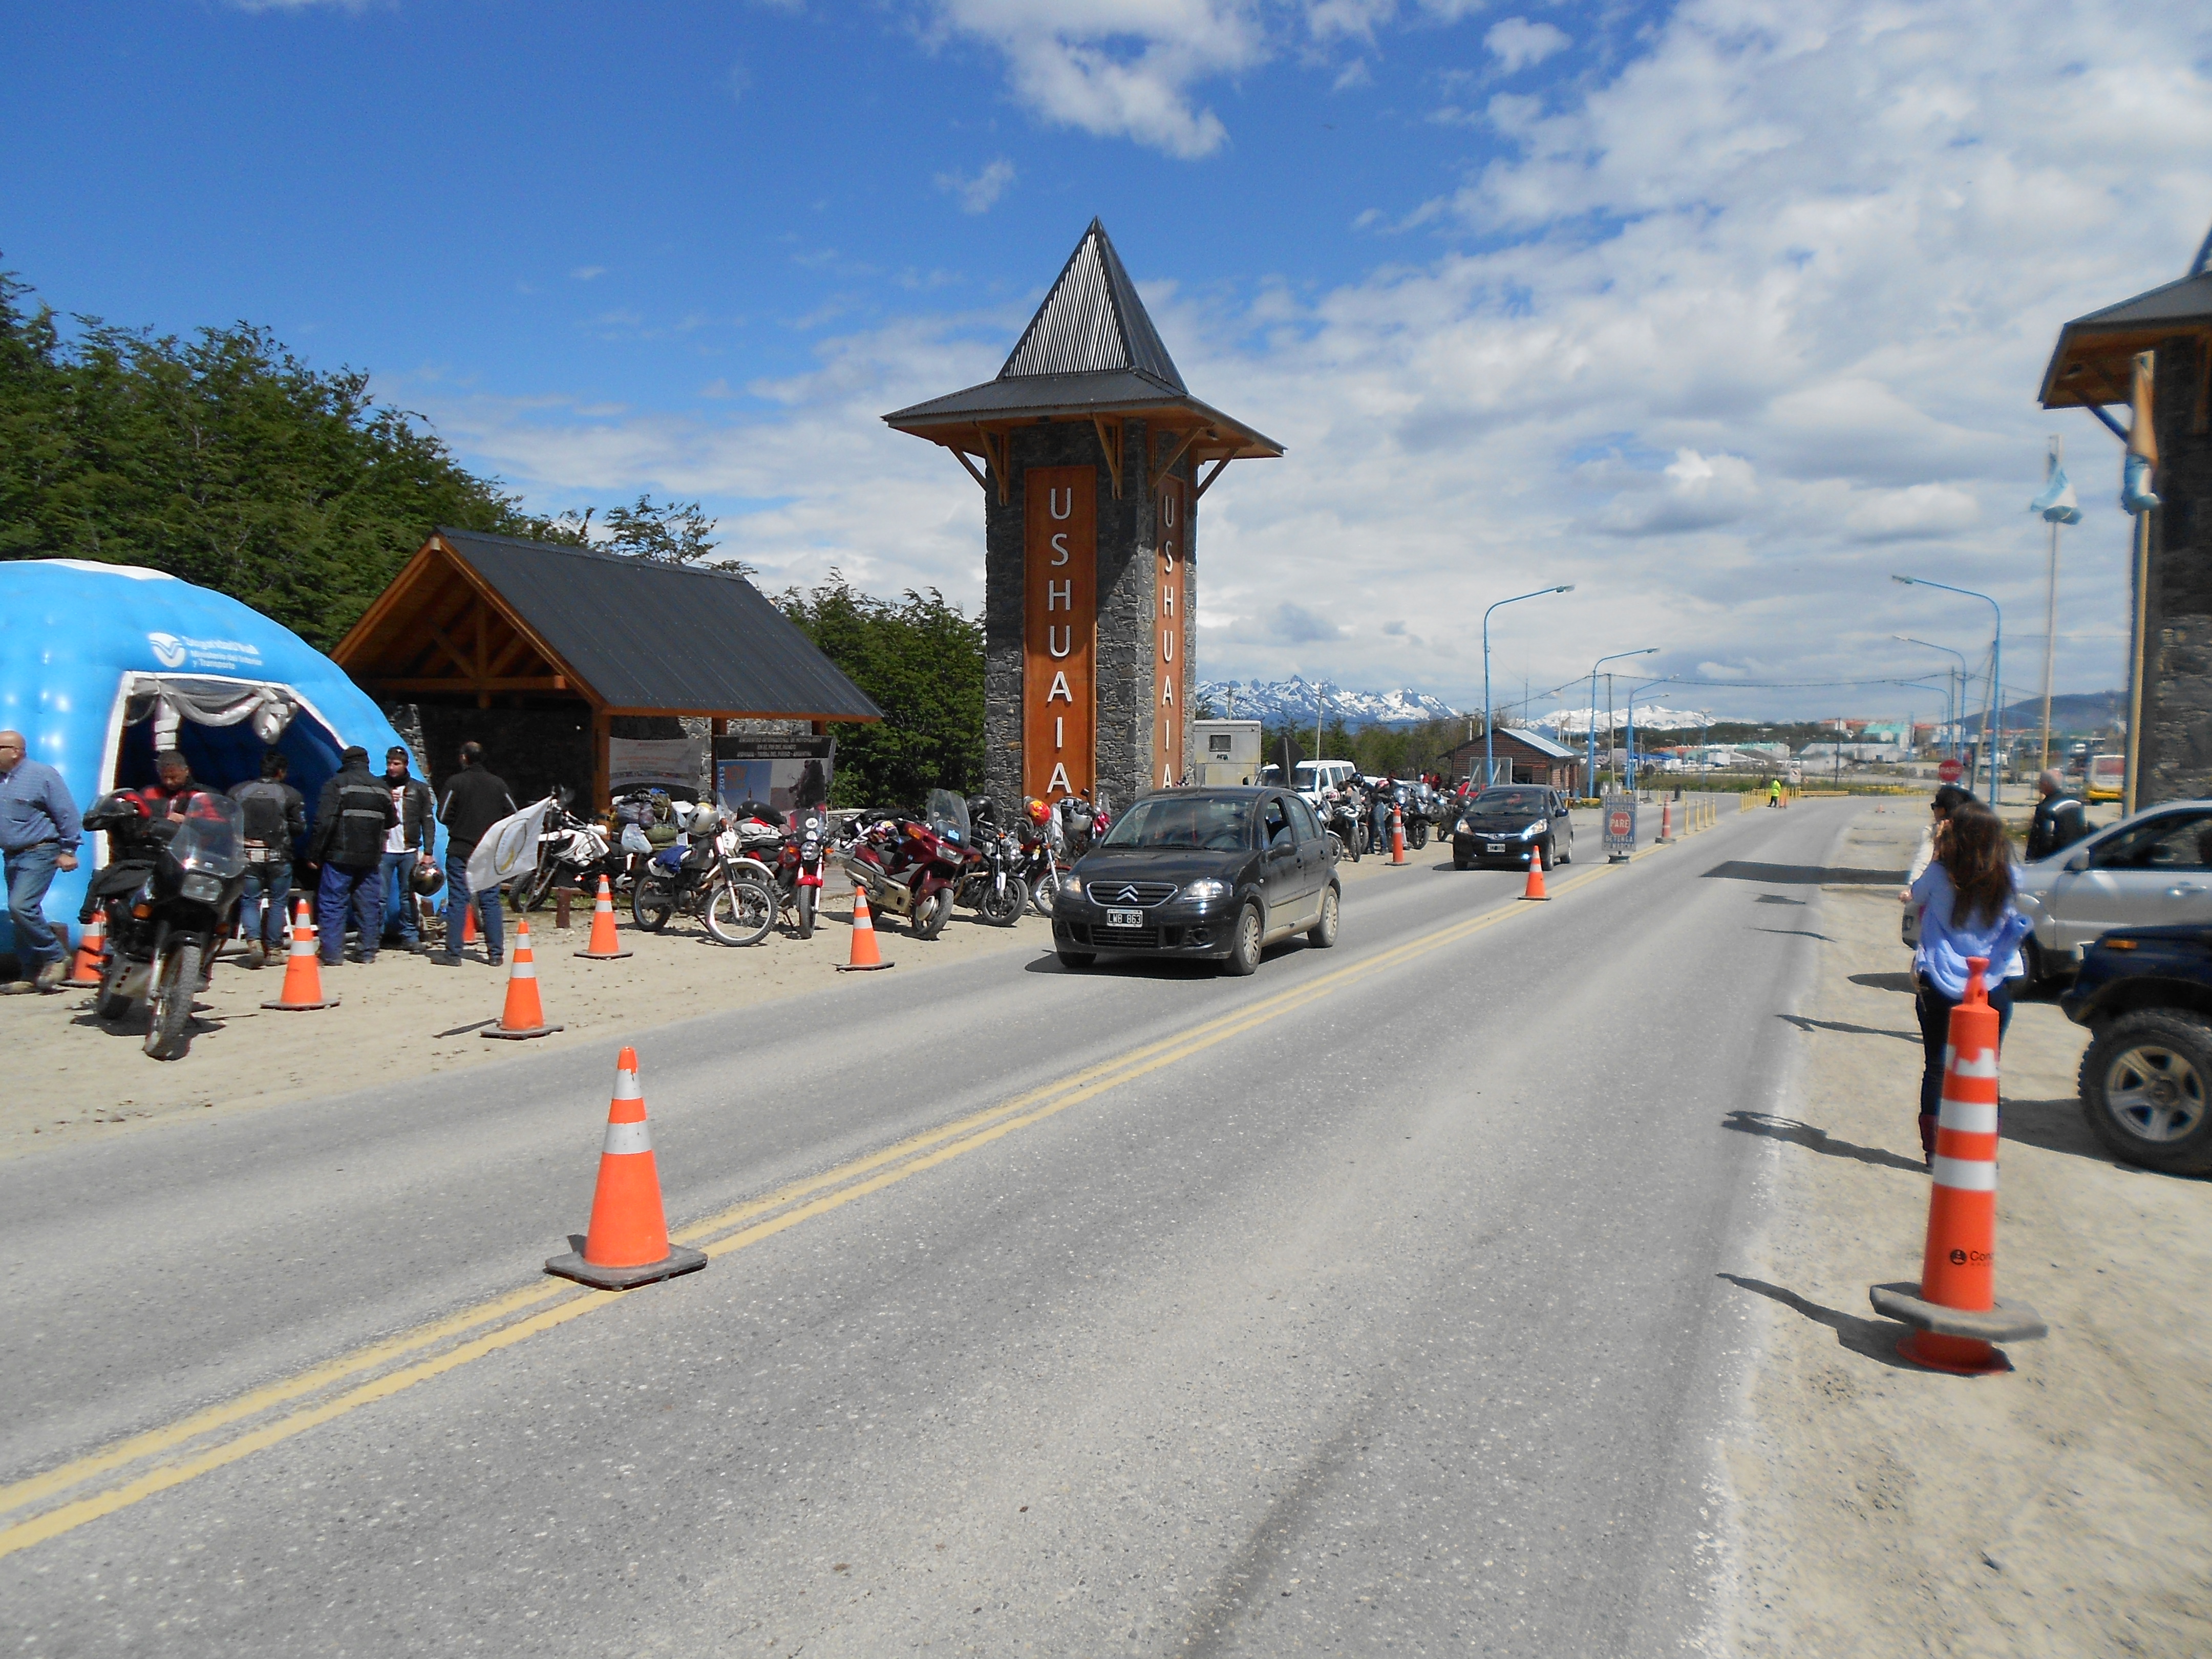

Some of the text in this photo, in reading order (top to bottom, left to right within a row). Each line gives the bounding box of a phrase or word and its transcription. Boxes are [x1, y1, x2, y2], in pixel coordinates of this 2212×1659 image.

[1047, 487, 1072, 794] USHUAIA
[1162, 495, 1174, 788] USHUAIA
[1610, 819, 1629, 828] PARE
[1126, 914, 1141, 924] 863
